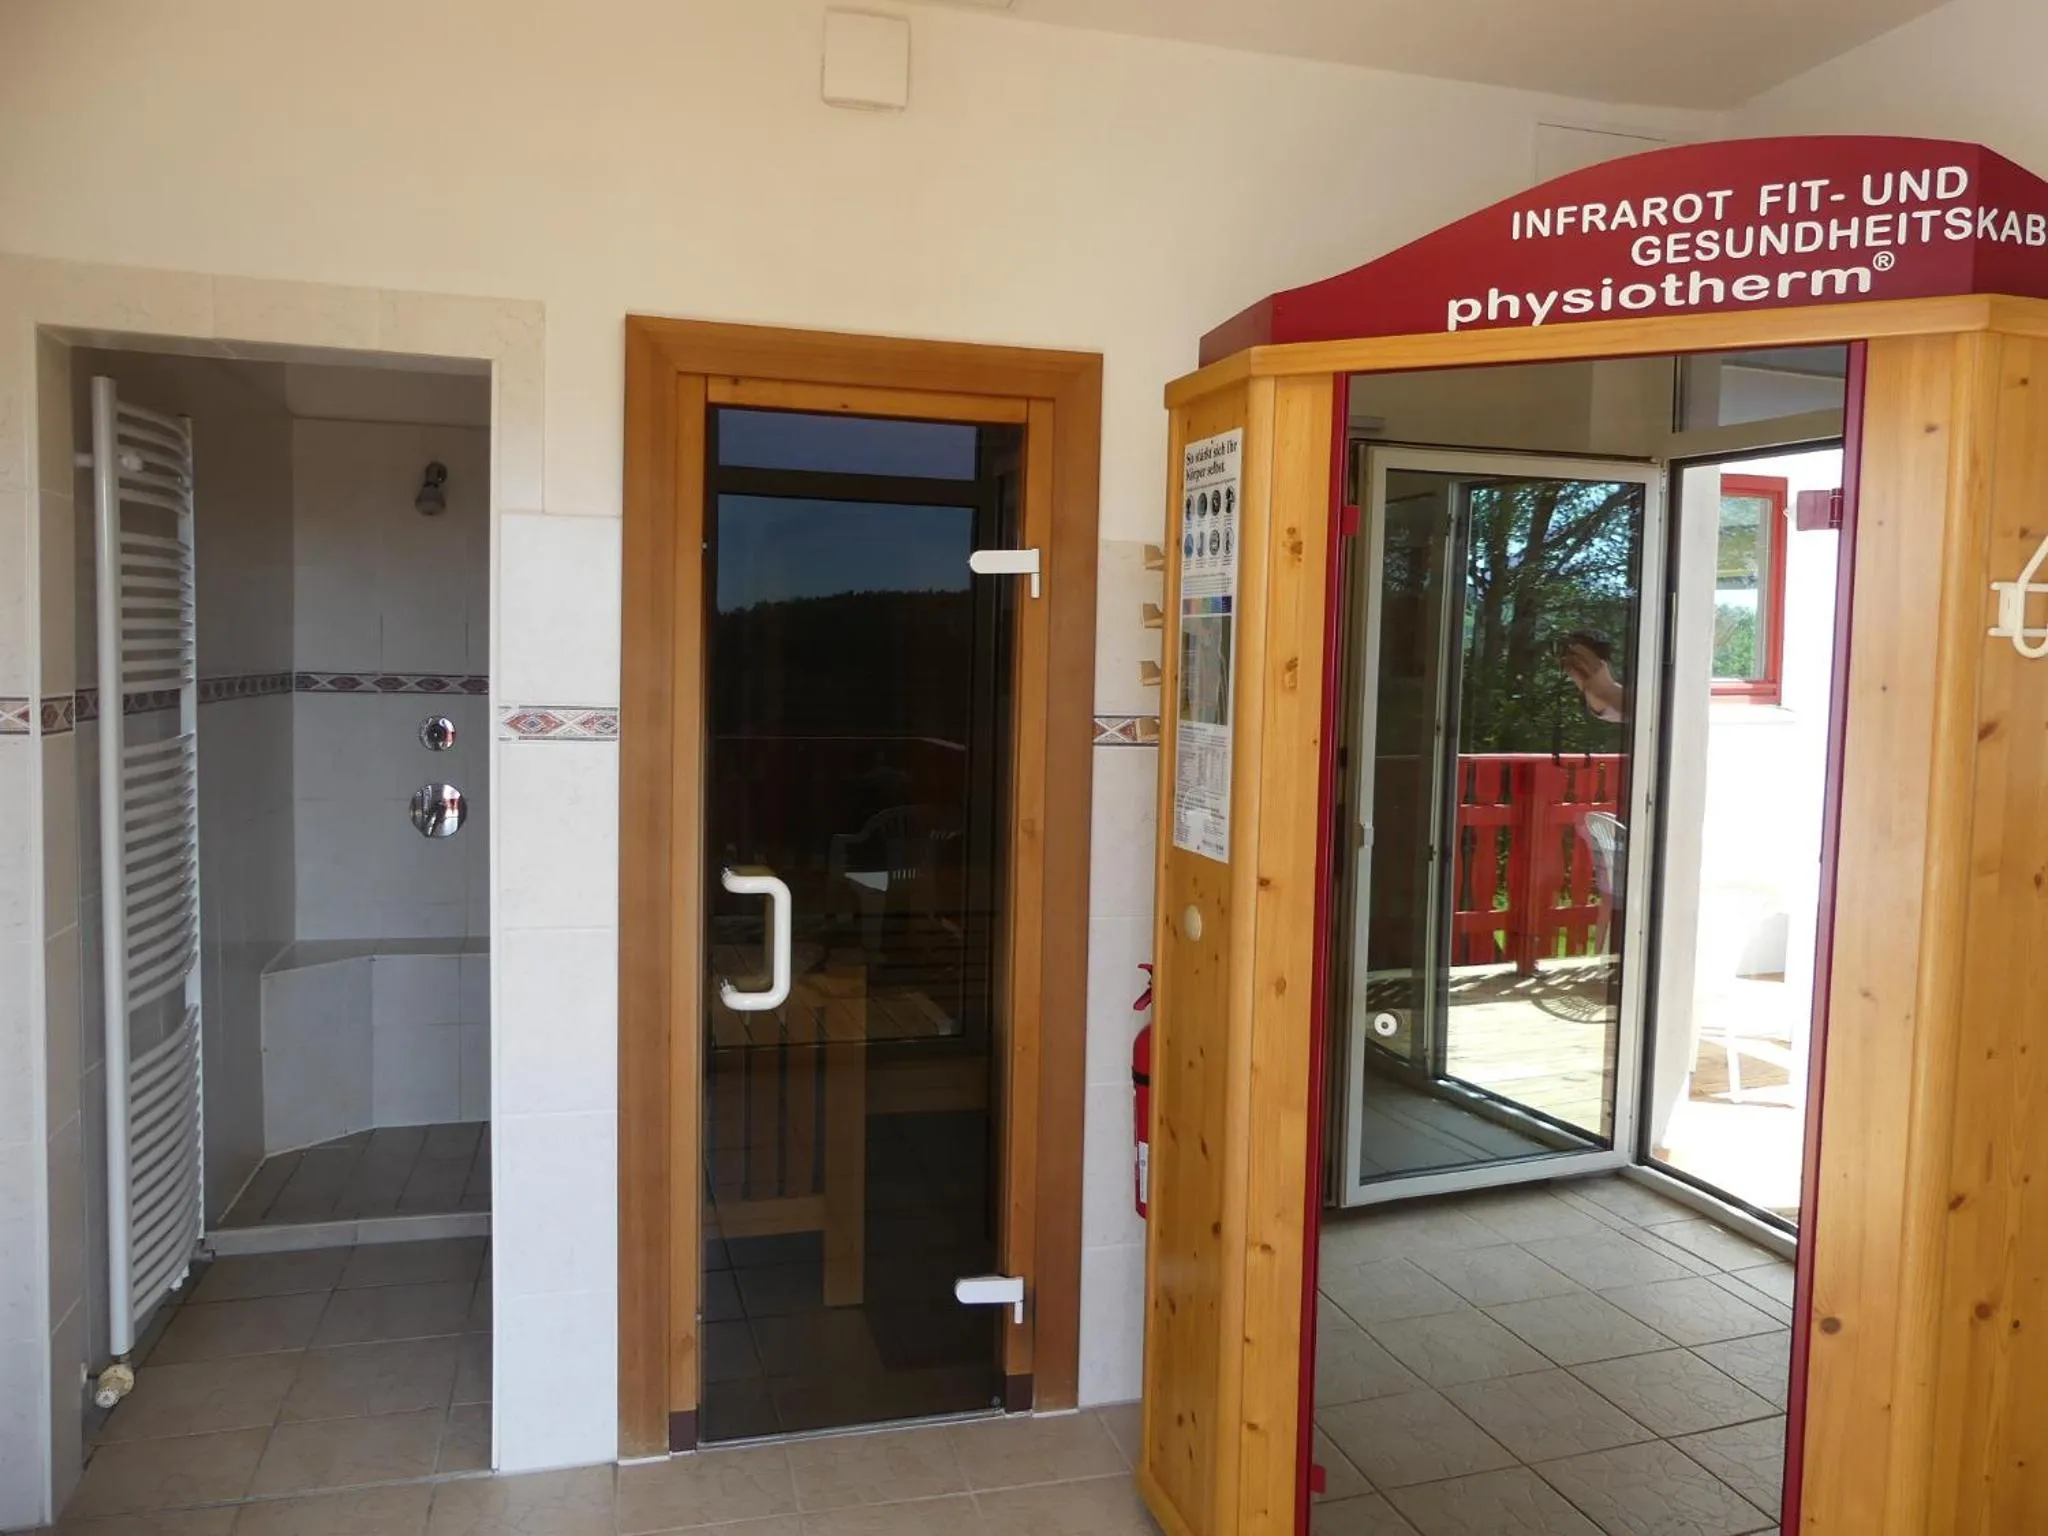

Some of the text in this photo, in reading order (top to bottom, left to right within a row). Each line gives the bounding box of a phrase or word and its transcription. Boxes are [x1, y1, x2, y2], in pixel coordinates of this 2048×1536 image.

[1511, 165, 1969, 241] INFRAROT FIT- UND
[1631, 206, 2047, 268] GESUNDHEITSKAB
